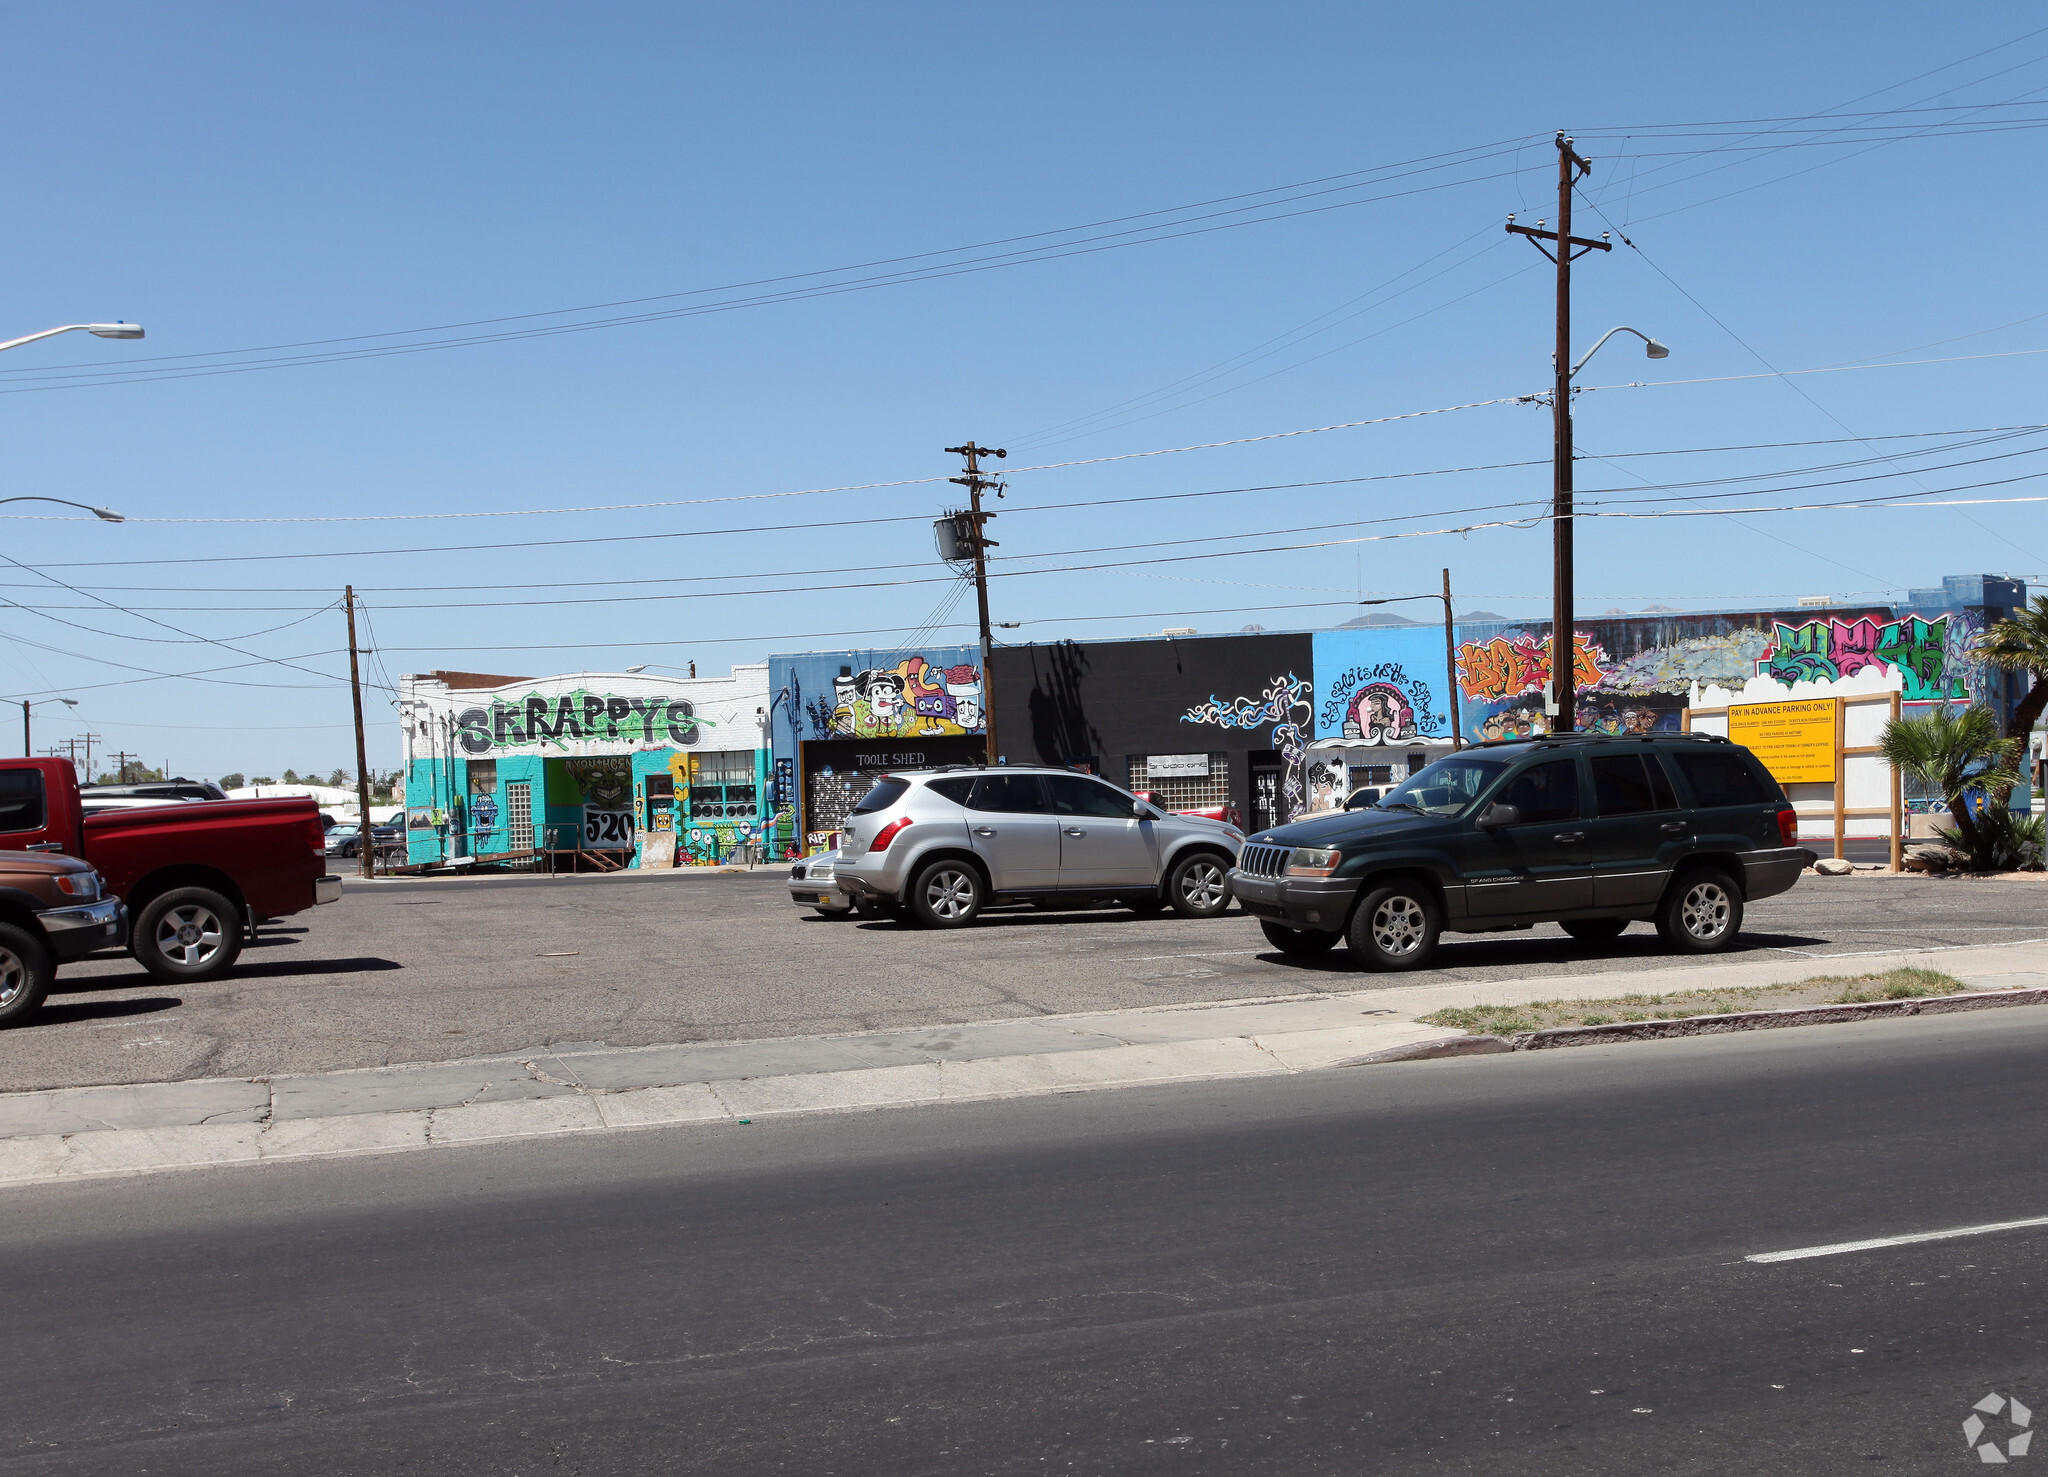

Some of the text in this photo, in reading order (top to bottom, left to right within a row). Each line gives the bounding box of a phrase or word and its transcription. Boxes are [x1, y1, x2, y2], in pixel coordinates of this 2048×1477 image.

[1731, 702, 1833, 717] PAY IN ADVANCE PARKING ONLY!
[460, 695, 699, 754] SKRAPPYS
[856, 752, 926, 767] TOOLE SHED
[586, 812, 634, 842] 520
[807, 832, 828, 845] RIP
[1492, 875, 1525, 883] CHEROKEE
